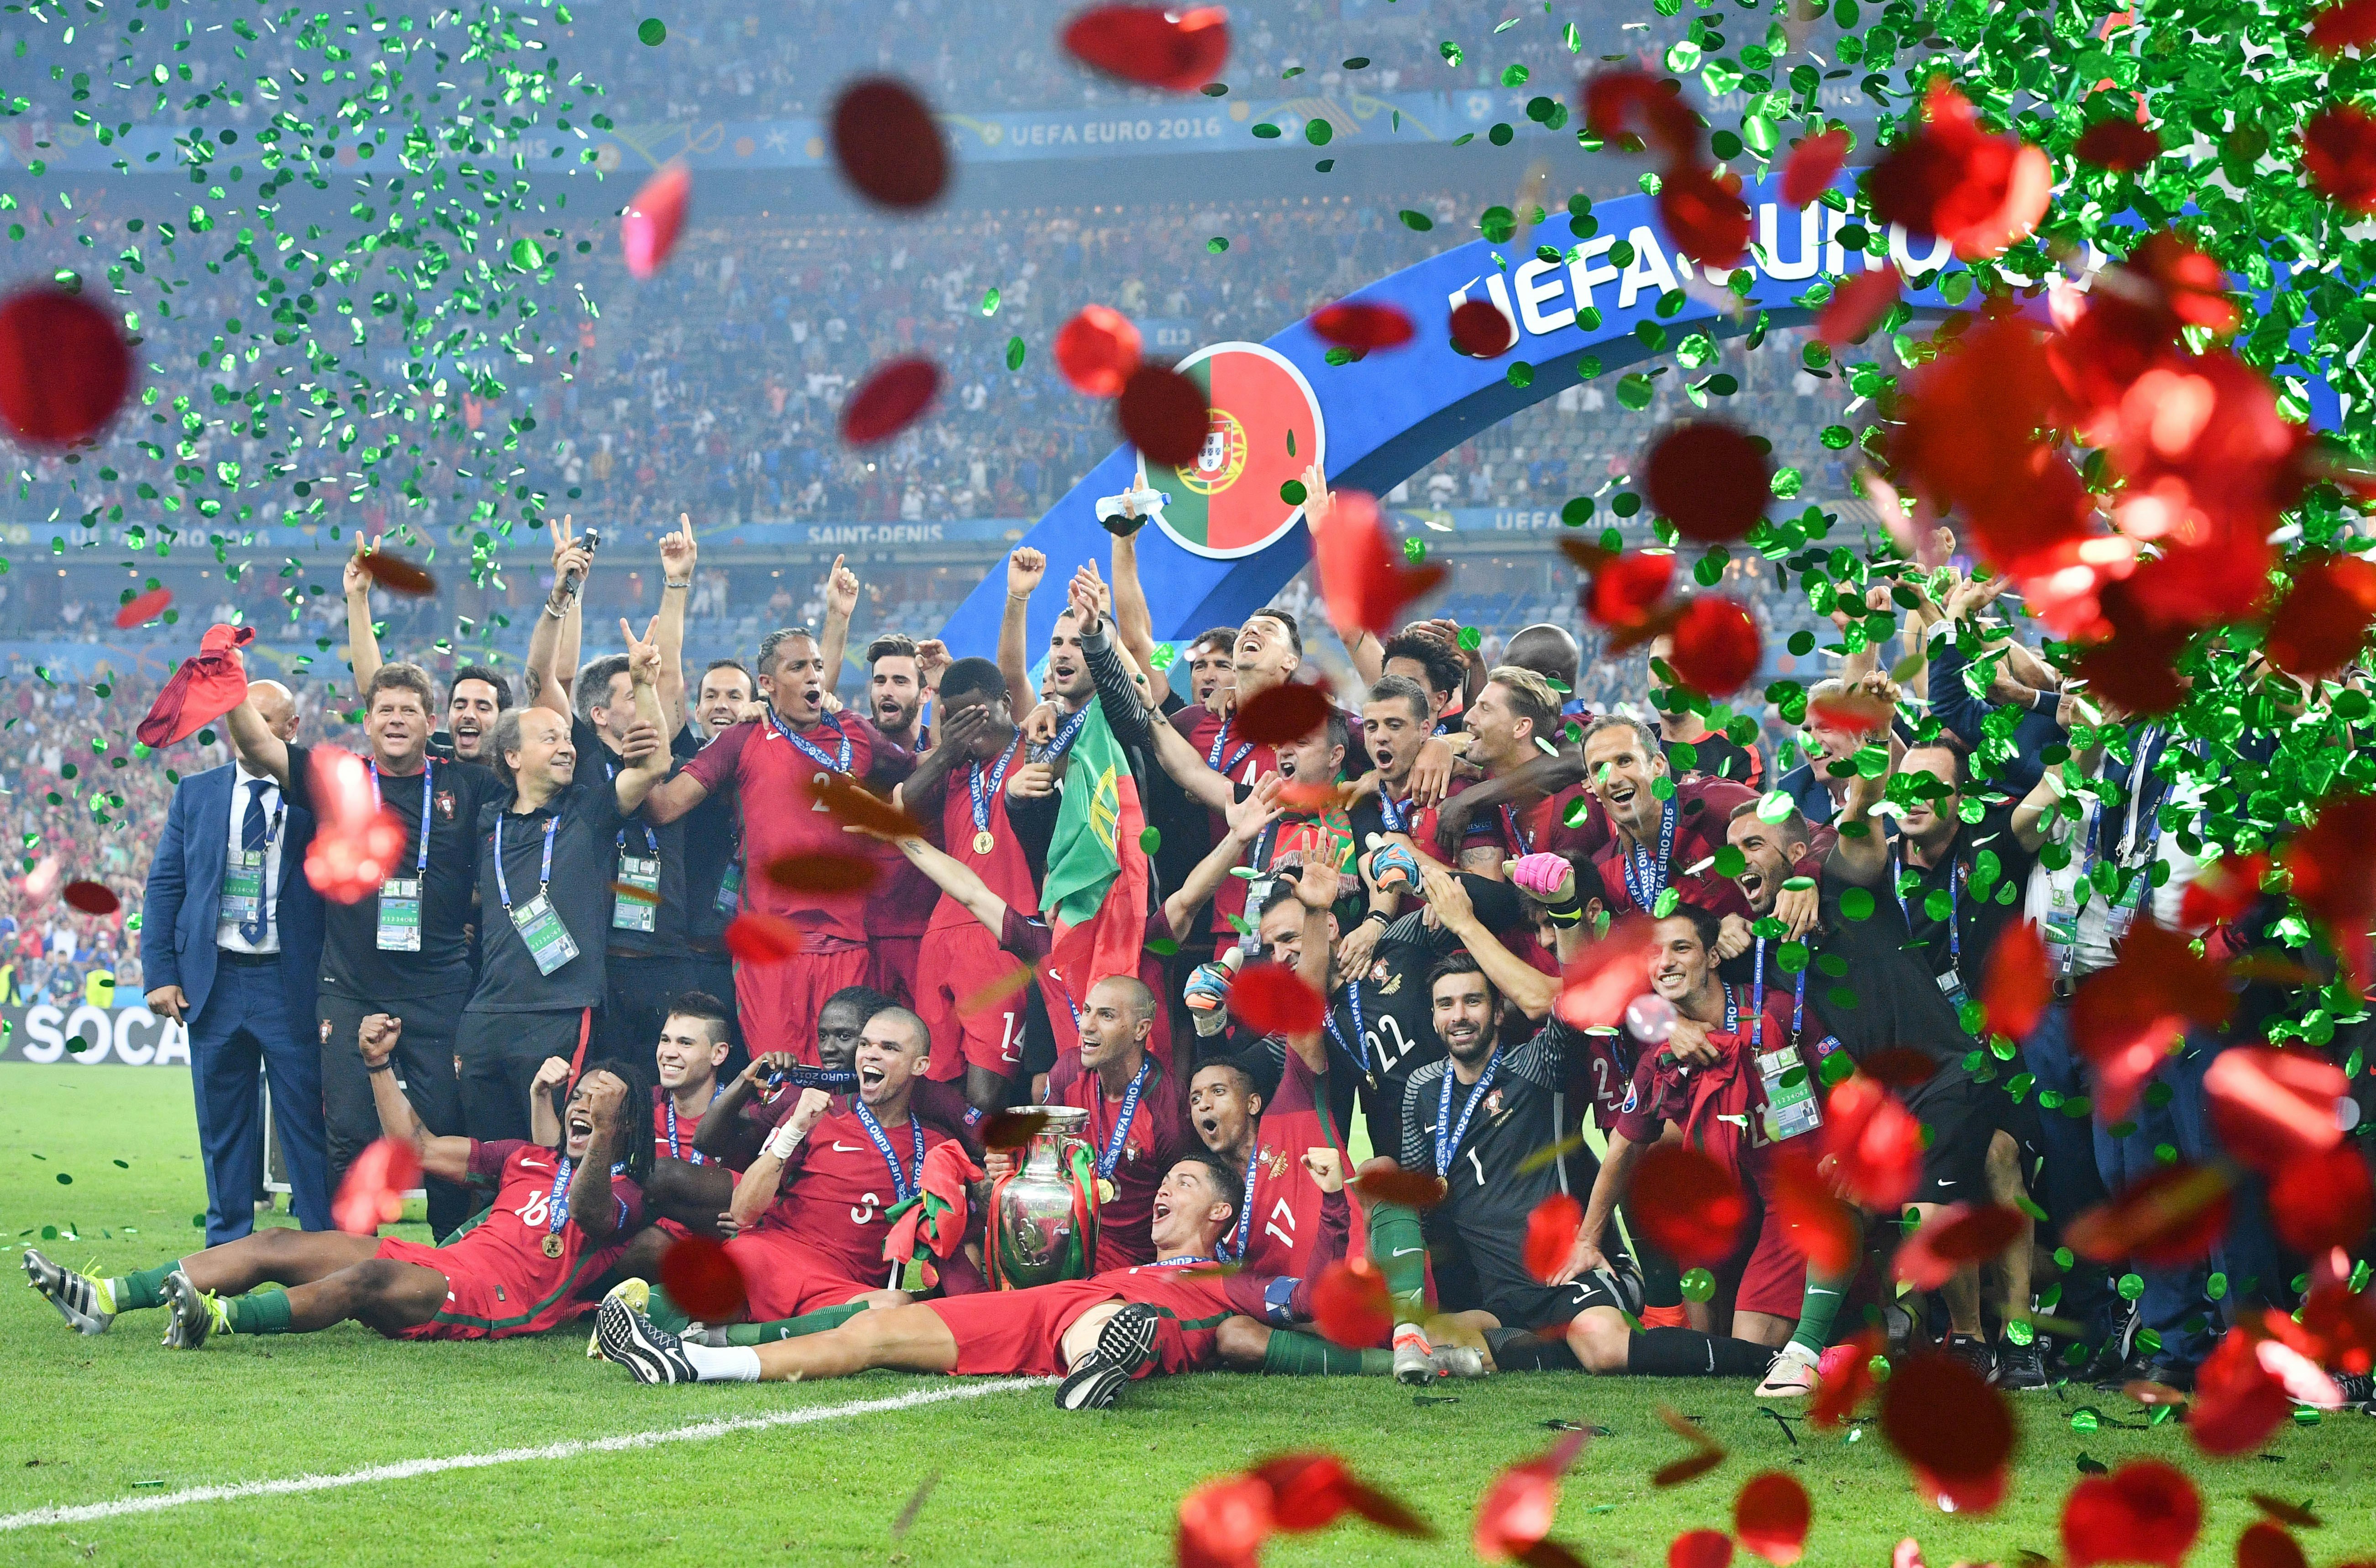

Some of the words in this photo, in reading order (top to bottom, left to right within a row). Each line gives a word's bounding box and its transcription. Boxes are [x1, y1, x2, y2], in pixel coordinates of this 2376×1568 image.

[1012, 123, 1077, 146] UEFA
[1084, 121, 1151, 143] EURO
[1159, 117, 1221, 139] 2016
[808, 524, 943, 545] SAINT-DENIS
[1495, 510, 1562, 530] UEFA
[841, 740, 851, 762] EURO
[1052, 725, 1074, 751] EURO
[993, 754, 1010, 779] EURO
[971, 777, 981, 802] UEFA
[1467, 821, 1493, 830] RESPECT
[1662, 808, 1673, 837] 2016
[1658, 839, 1670, 871] EURO
[1640, 868, 1649, 898] 2016
[1352, 1000, 1362, 1031] UEFA
[1364, 1014, 1416, 1073] 22
[821, 1073, 850, 1081] EURO
[1479, 1058, 1500, 1086] UEFA
[1441, 1074, 1452, 1104] EURO
[1465, 1086, 1485, 1117] EURO
[855, 1101, 874, 1130] 2016
[1112, 1117, 1130, 1147] UEFA
[1123, 1087, 1138, 1117] EURO
[1437, 1105, 1448, 1135] UEFA
[1451, 1116, 1469, 1144] 2016
[869, 1126, 891, 1153] EURO
[914, 1131, 923, 1160] EURO
[886, 1152, 902, 1181] UEFA
[913, 1161, 923, 1189] 2016
[1466, 1146, 1485, 1186] 1
[552, 1177, 566, 1198] UEFA
[1244, 1171, 1256, 1203] EURO
[514, 1190, 551, 1226] 16
[850, 1193, 880, 1225] 3
[1241, 1204, 1251, 1234] 2016
[1264, 1196, 1296, 1248] 17
[1160, 1257, 1192, 1266] EURO
